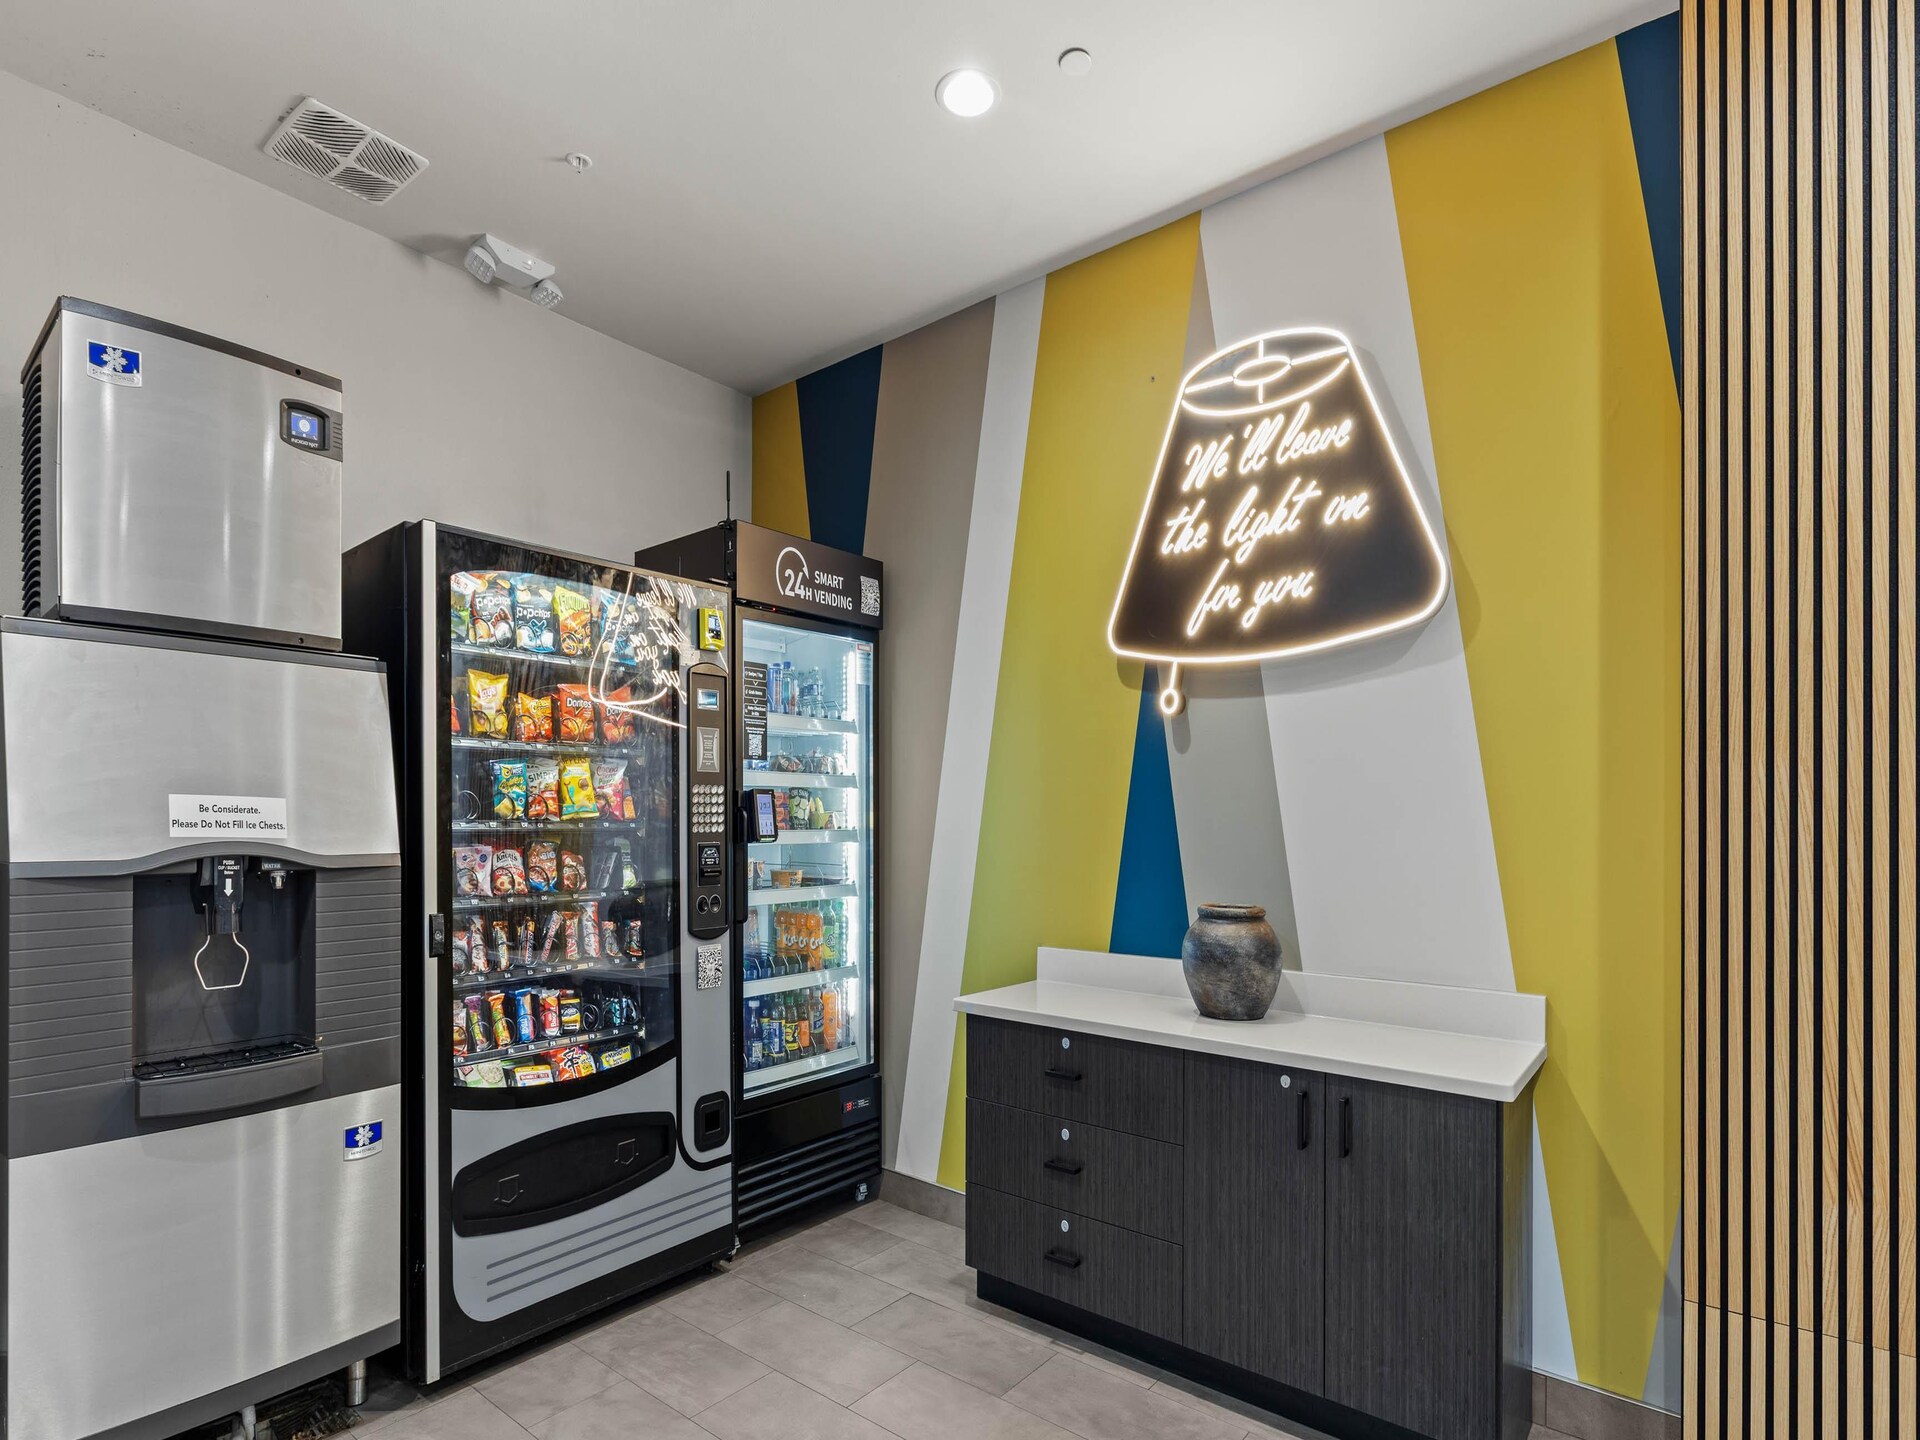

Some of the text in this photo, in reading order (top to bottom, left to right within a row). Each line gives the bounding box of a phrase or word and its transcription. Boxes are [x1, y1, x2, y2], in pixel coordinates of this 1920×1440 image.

[1182, 401, 1353, 492] We'll leave
[1161, 477, 1370, 564] the light on
[814, 571, 844, 590] SMART
[814, 590, 853, 611] VENDING
[1186, 559, 1314, 637] for you
[199, 804, 261, 815] Be Considerate.
[171, 819, 286, 830] Please Do Not Fill Ice Chests.
